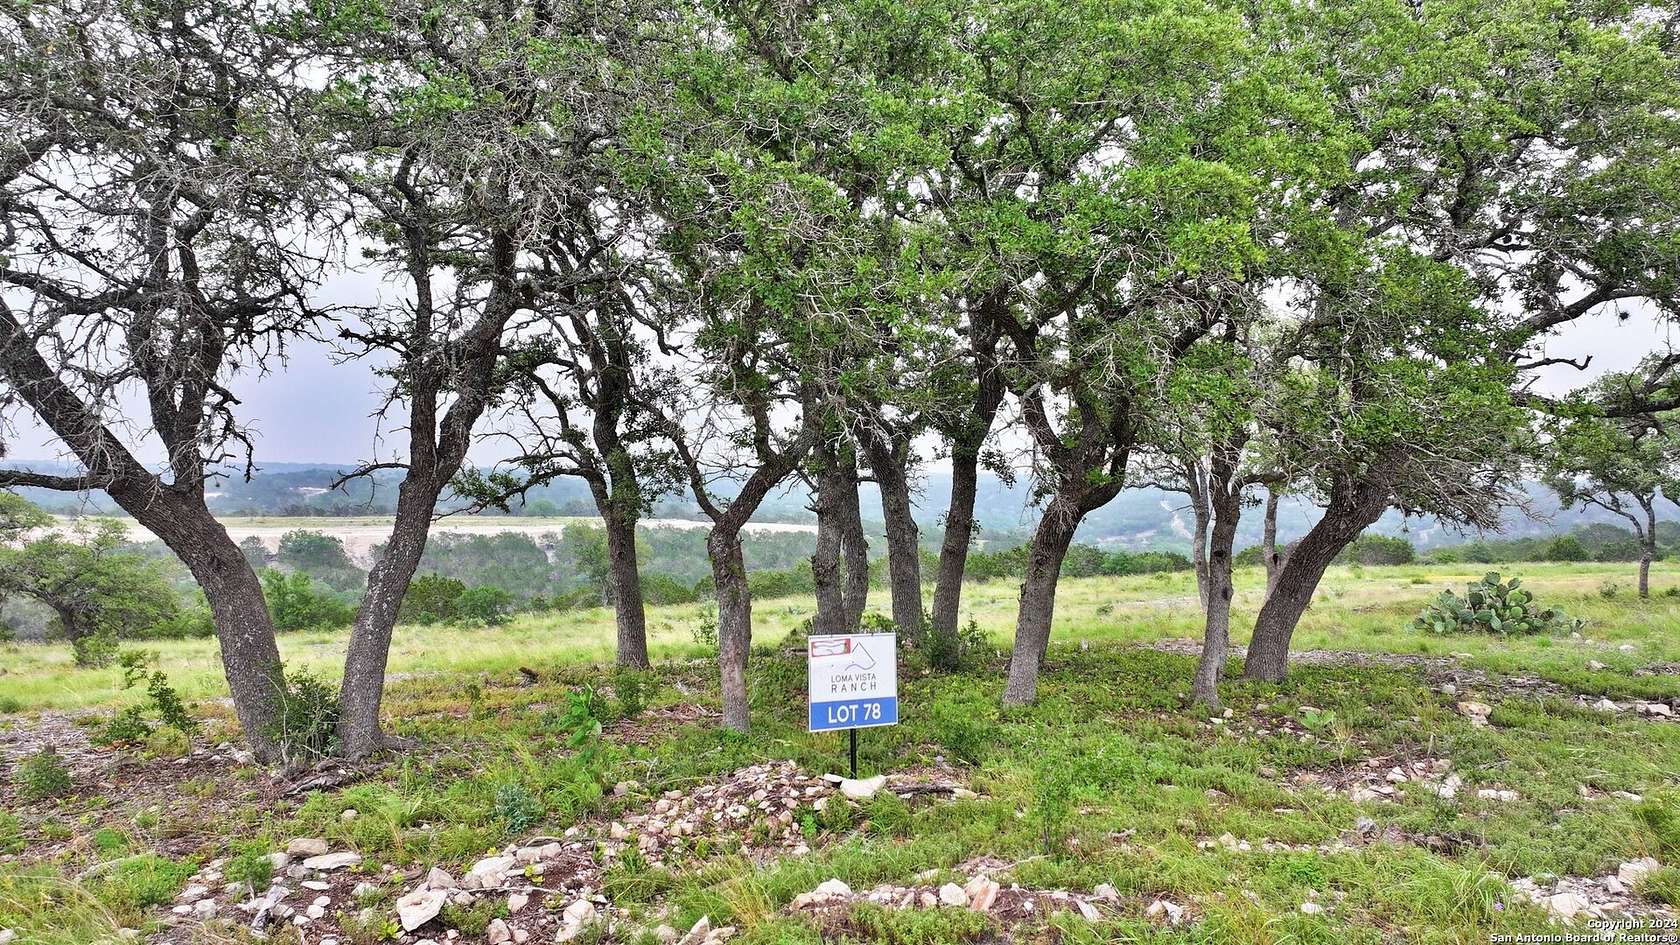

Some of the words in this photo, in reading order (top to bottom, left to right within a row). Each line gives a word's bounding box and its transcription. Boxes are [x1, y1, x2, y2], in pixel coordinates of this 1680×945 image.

[831, 674, 853, 683] LOMA
[855, 673, 877, 681] VISTA
[831, 682, 877, 693] RANCH
[828, 705, 859, 723] LOT
[863, 703, 881, 720] 78
